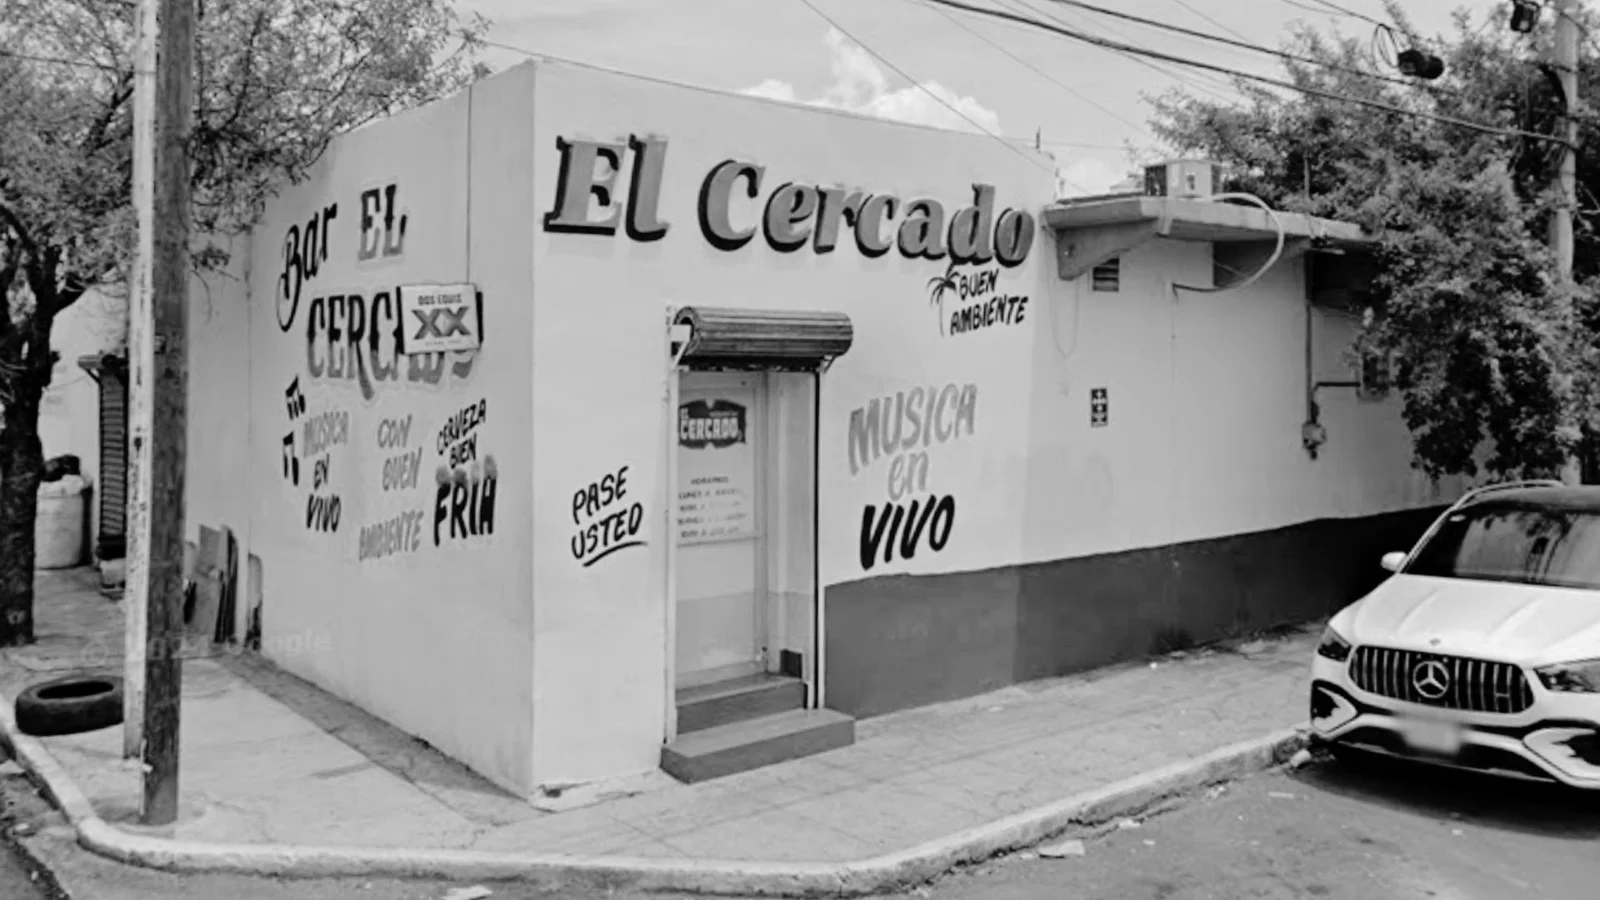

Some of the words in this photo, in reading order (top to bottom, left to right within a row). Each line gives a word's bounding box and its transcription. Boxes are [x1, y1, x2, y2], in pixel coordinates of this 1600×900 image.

[543, 134, 670, 242] El
[697, 158, 1034, 268] Cercado
[276, 203, 338, 332] Bar
[357, 183, 407, 261] EL
[960, 268, 999, 301] BUEN
[411, 306, 472, 340] XX
[950, 294, 1028, 336] AMBIENTE
[307, 288, 484, 400] CERC
[377, 414, 412, 448] CON
[437, 398, 487, 456] CERVEZA
[449, 431, 477, 469] BIEN
[680, 417, 739, 440] CERCADO
[848, 383, 978, 476] MUSICA
[382, 447, 422, 492] BUEN
[572, 465, 629, 526] PASE
[888, 452, 929, 501] en
[306, 494, 341, 532] VIVO
[433, 460, 498, 547] FRIA
[359, 510, 425, 562] AMBIENTE
[571, 501, 644, 560] USTED
[860, 494, 955, 571] VIVO
